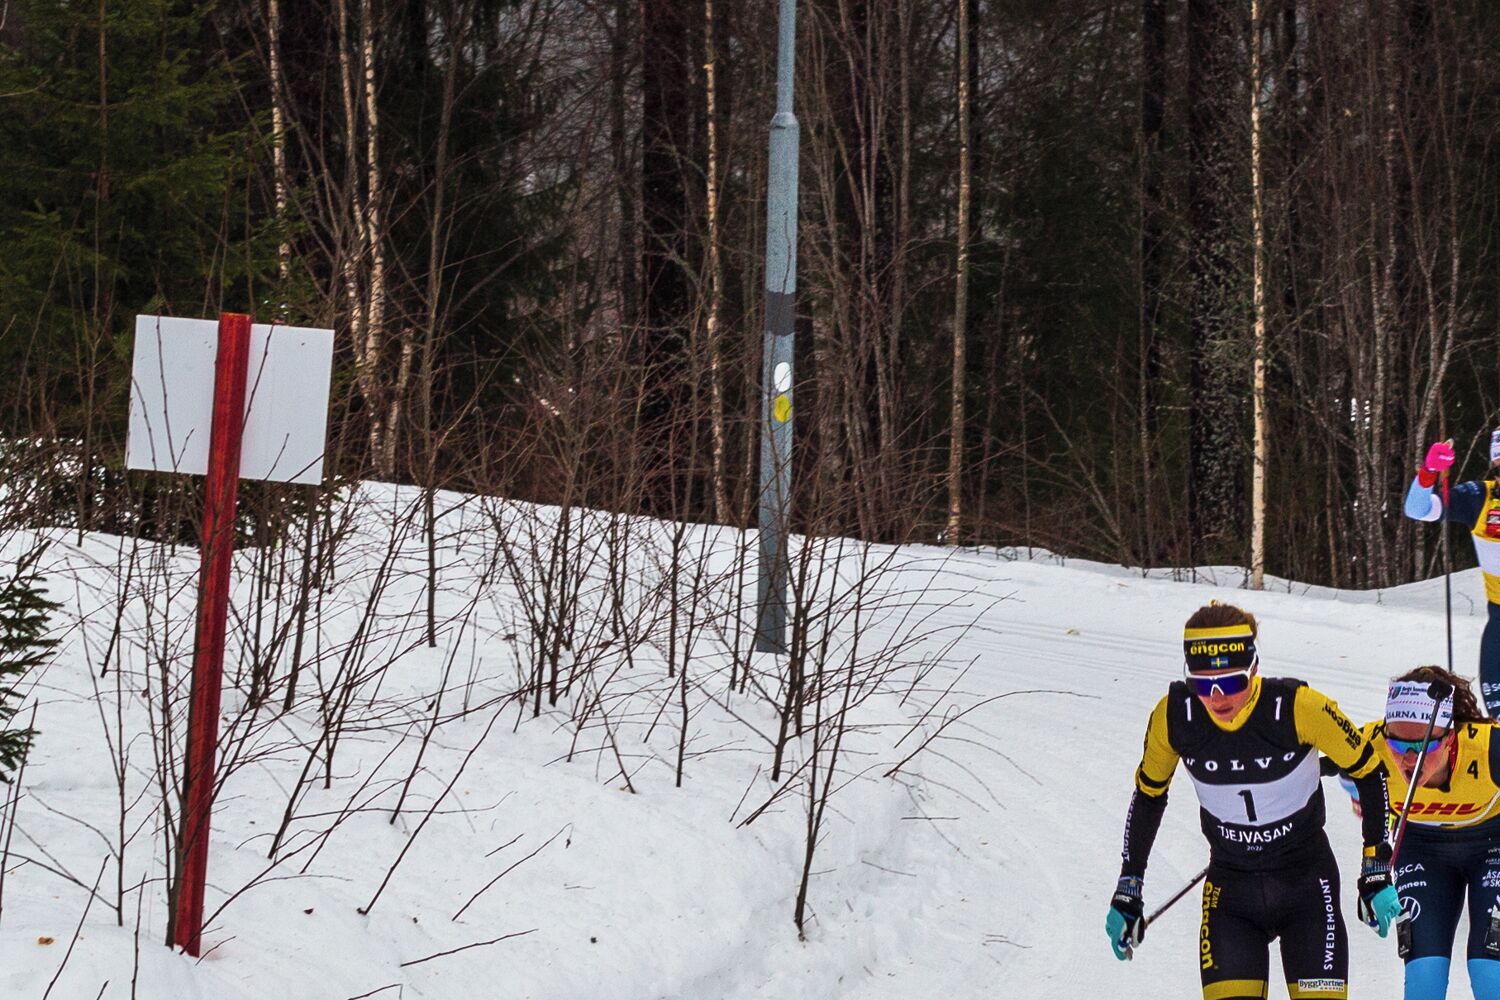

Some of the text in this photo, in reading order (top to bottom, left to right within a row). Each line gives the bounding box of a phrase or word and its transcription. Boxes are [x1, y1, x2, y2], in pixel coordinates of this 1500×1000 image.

[1190, 642, 1245, 656] engcon
[1185, 696, 1192, 722] 1
[1275, 696, 1282, 721] 1
[1325, 703, 1362, 746] engcon
[1467, 760, 1478, 779] 4
[1236, 790, 1257, 822] 1
[1395, 802, 1483, 816] DHL
[1211, 886, 1222, 909] TEAM
[1319, 877, 1336, 971] SWEDEMOUNT
